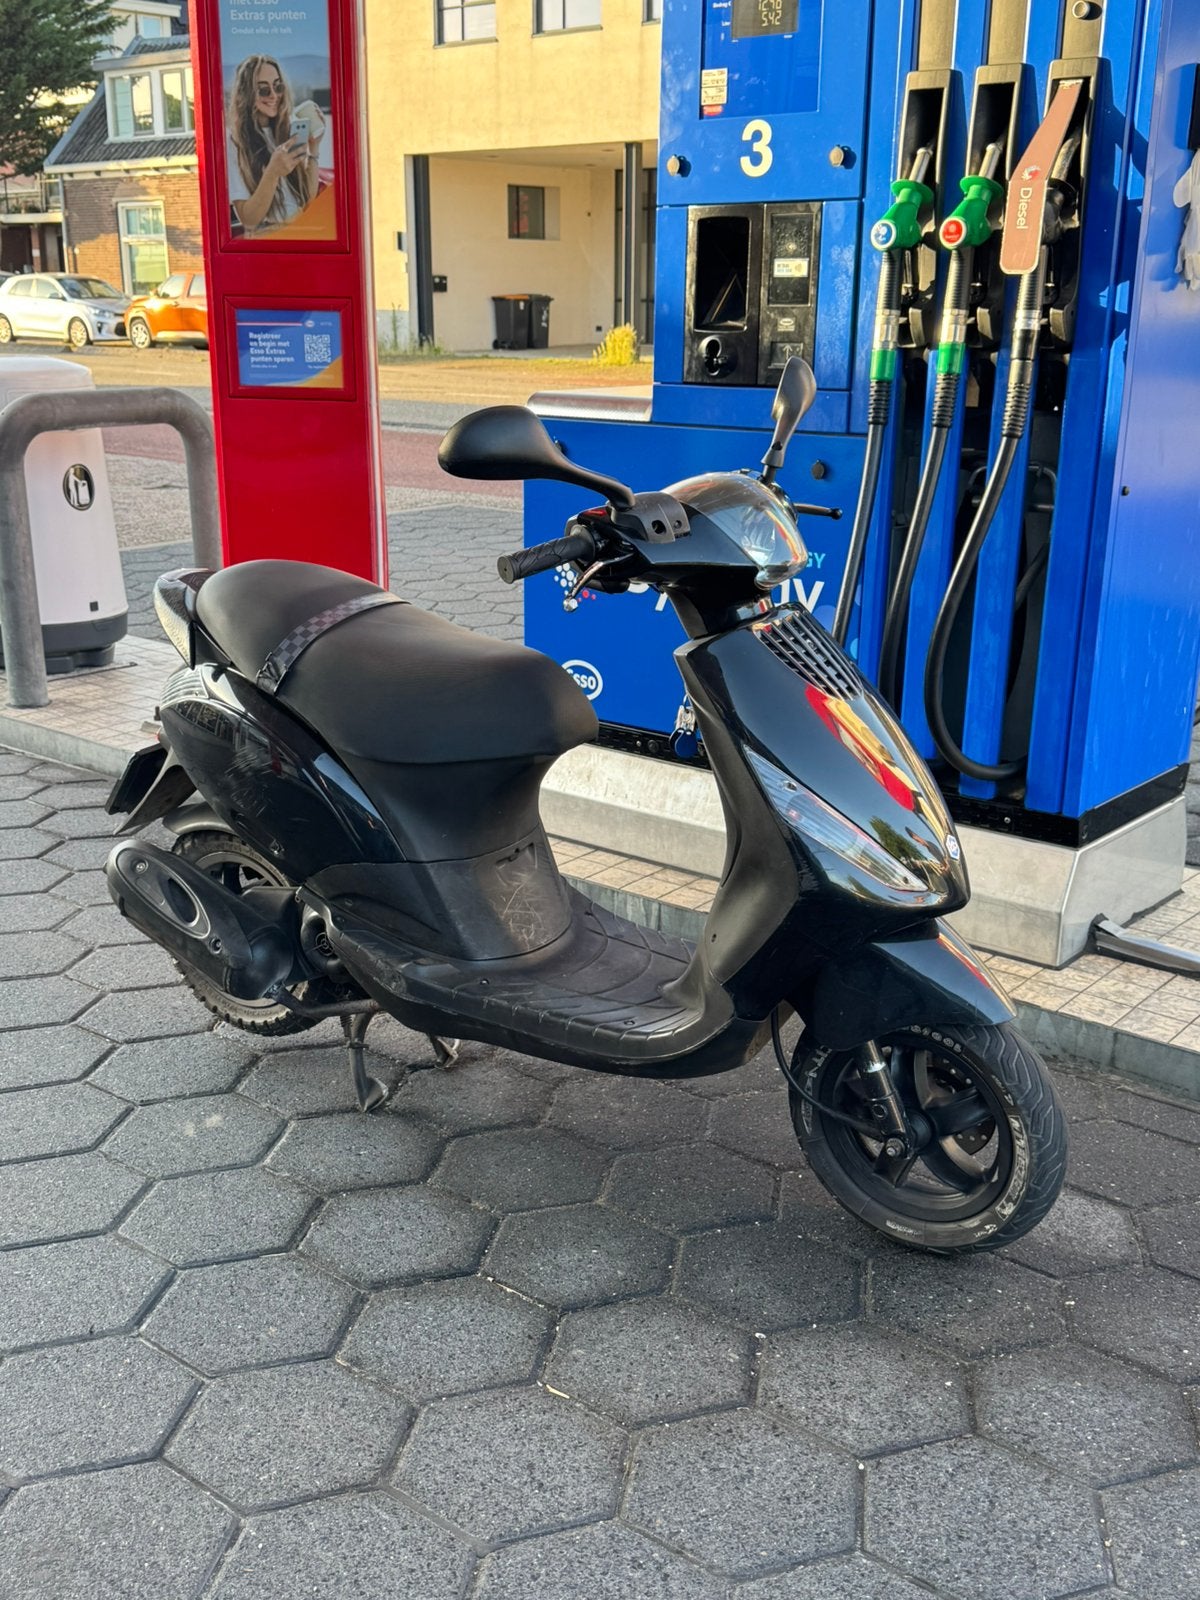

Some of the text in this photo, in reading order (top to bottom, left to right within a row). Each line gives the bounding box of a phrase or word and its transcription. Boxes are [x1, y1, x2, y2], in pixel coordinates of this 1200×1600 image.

[230, 10, 307, 23] Extras punten
[740, 119, 773, 177] 3
[1016, 187, 1033, 230] Diesel
